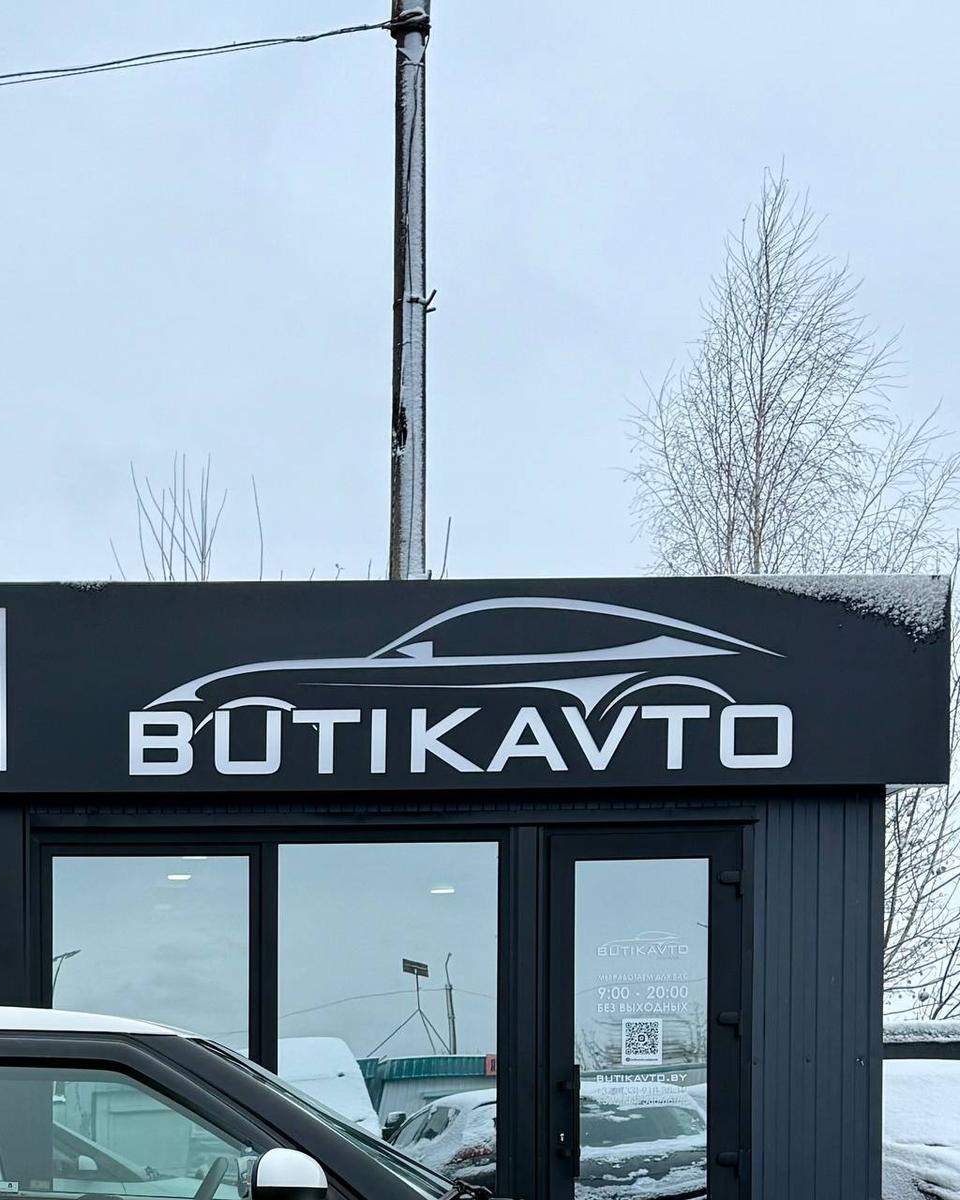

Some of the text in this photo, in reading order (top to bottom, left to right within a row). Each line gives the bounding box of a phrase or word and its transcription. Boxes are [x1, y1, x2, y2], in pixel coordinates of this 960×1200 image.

[128, 702, 794, 777] BUTIKAVTO
[597, 944, 688, 957] BUTIKAVTO
[598, 986, 630, 1000] 9:00
[647, 985, 688, 999] 20:00
[597, 1002, 688, 1013] БЕЗ ВЫХОДНЫХ
[596, 1073, 688, 1083] BUTIKAVTO.BY
